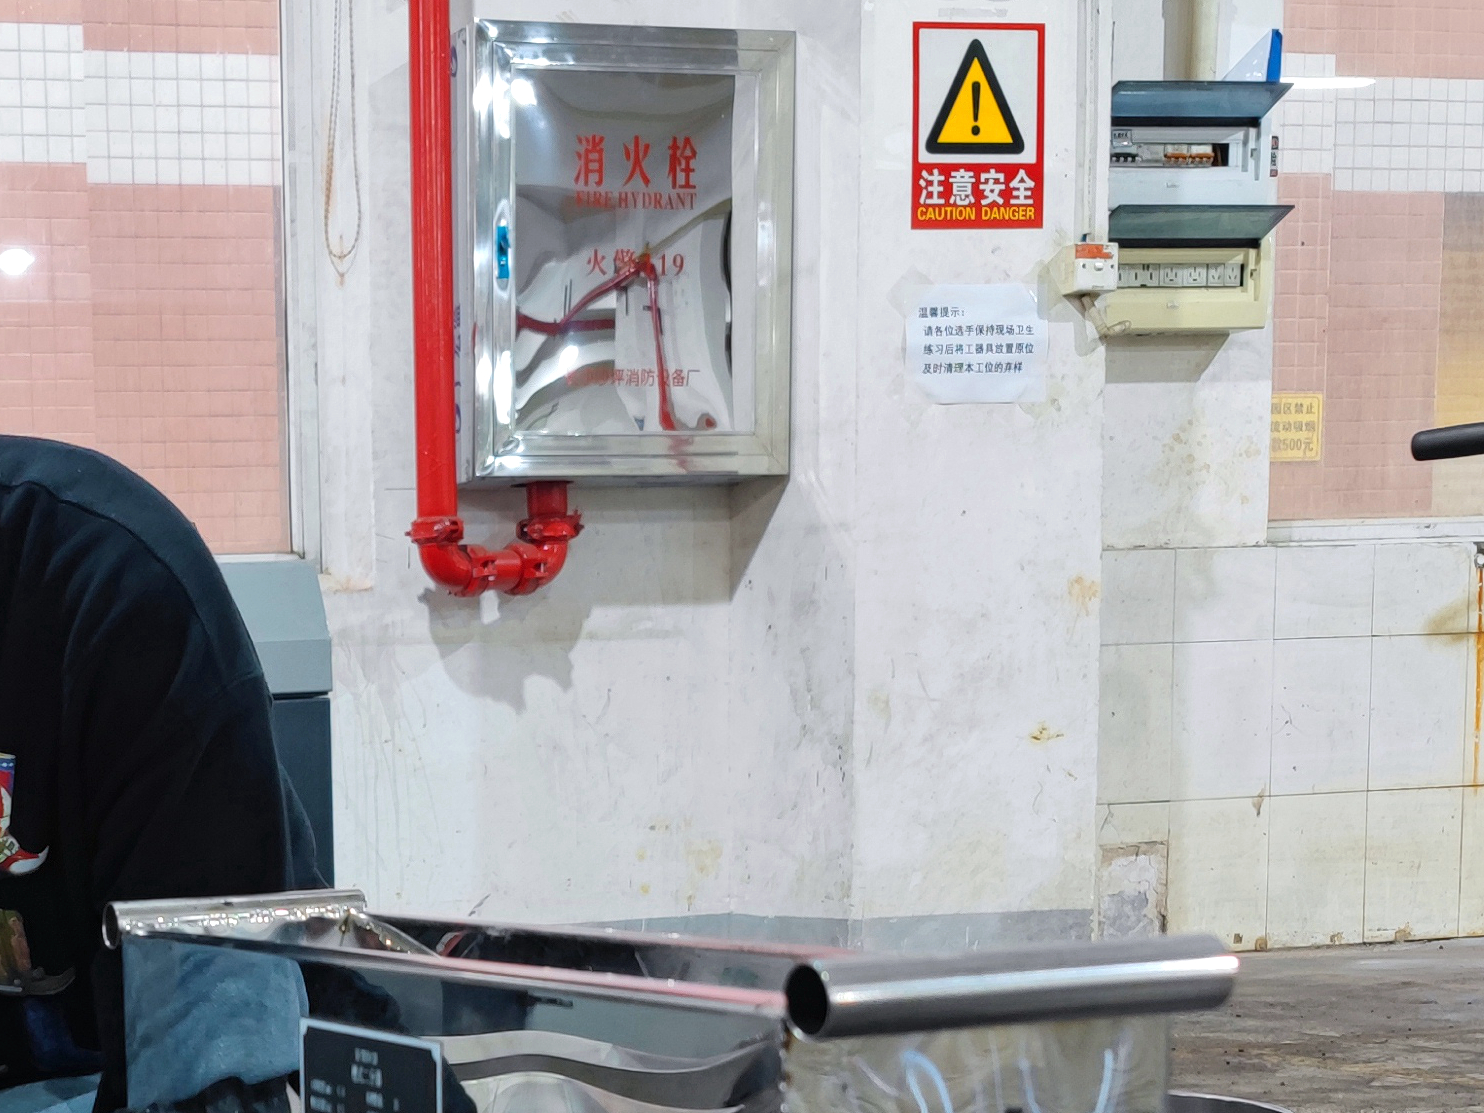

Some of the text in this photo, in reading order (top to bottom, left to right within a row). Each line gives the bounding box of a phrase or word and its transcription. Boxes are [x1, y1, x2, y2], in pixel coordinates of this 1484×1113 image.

[574, 134, 697, 189] 消火栓
[918, 168, 1035, 206] 注意安全
[576, 190, 697, 211] FIRE HYDRANT
[917, 206, 1035, 221] CAUTION DANGER
[918, 306, 965, 318] 温馨提示：
[924, 324, 1035, 336] 请各位选手保持现场卫生
[923, 342, 1034, 355] 练习后将工器具放置原位
